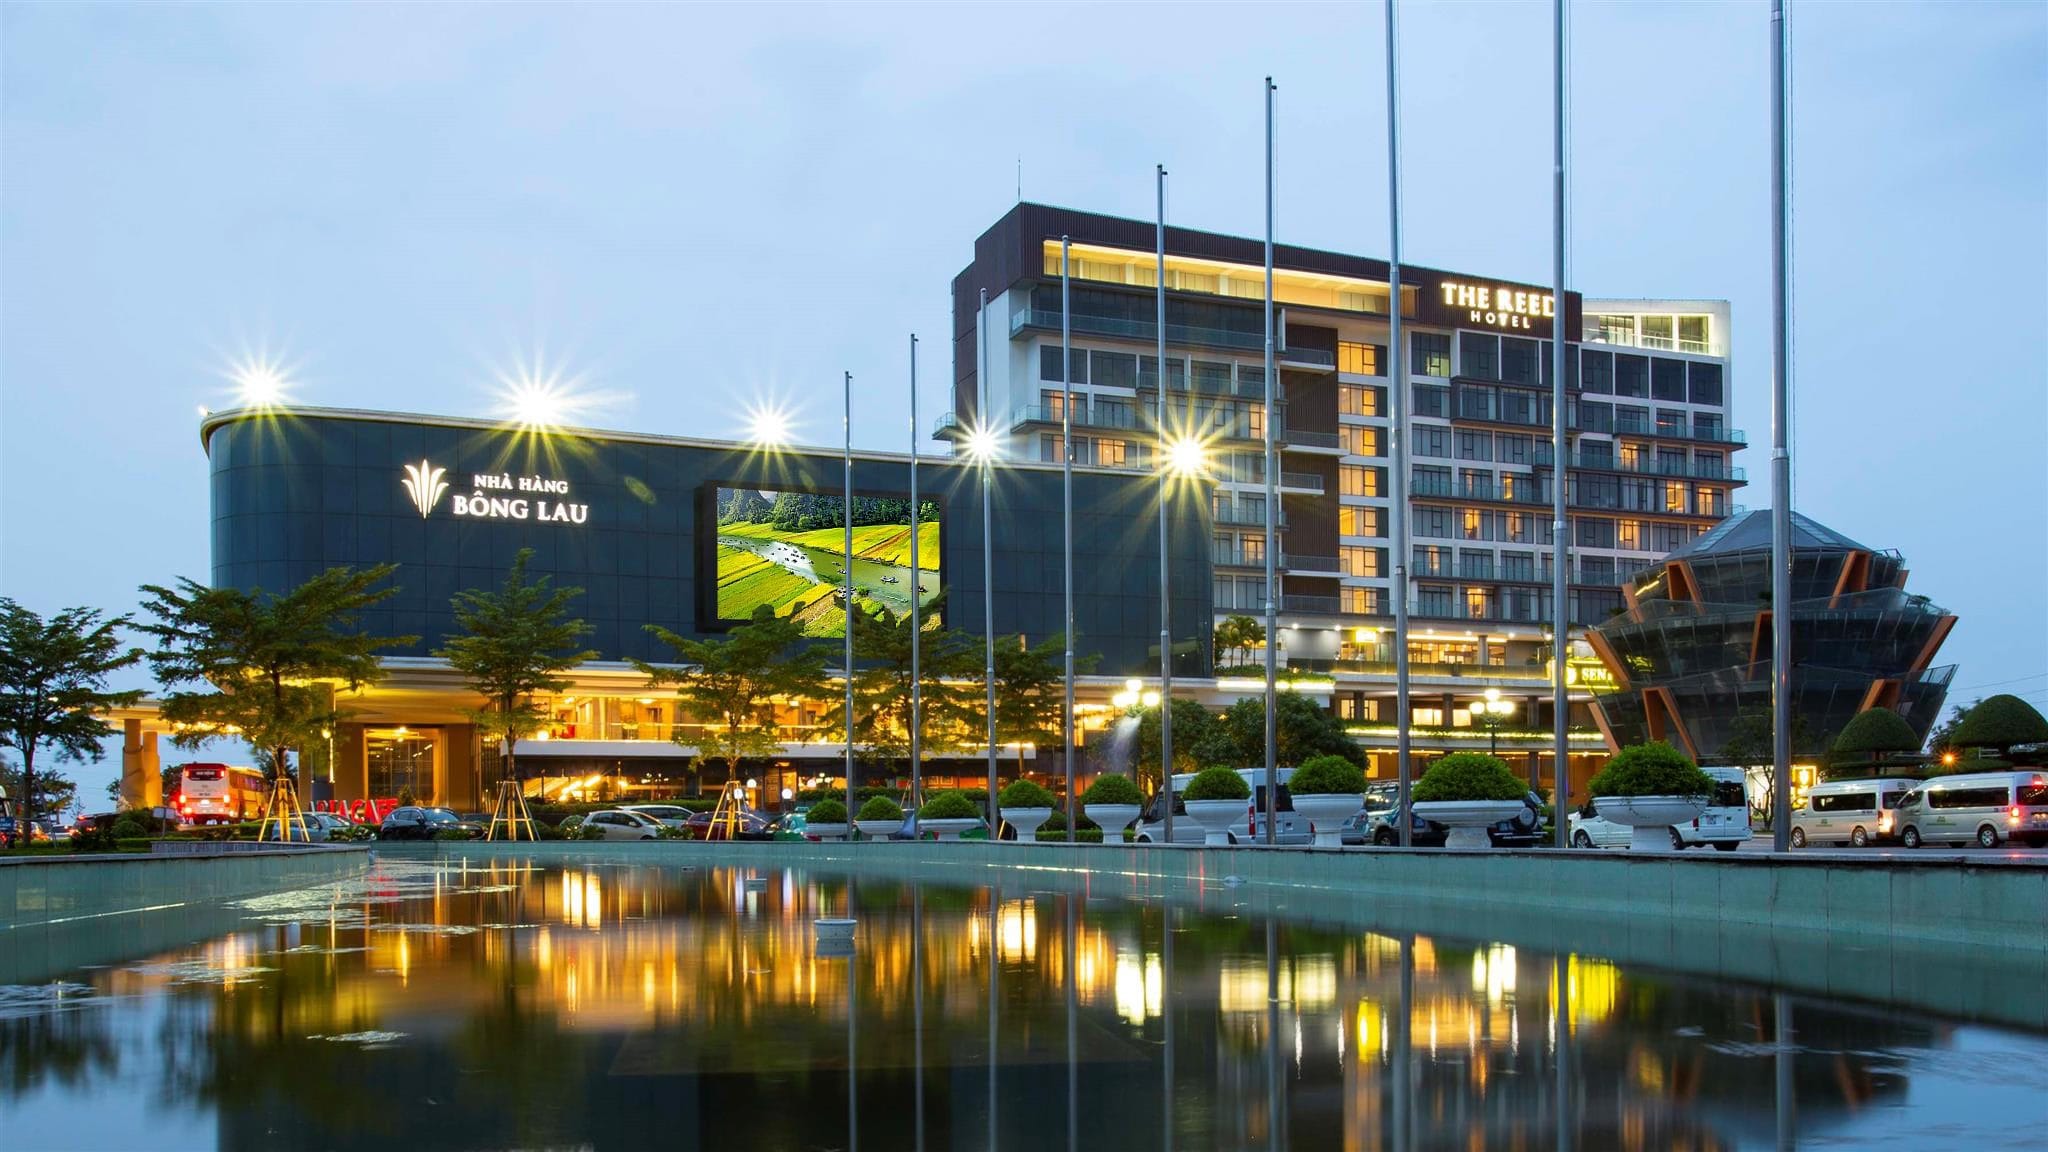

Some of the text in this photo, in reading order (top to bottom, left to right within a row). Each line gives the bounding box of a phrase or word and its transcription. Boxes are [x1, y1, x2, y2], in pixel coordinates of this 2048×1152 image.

[1440, 281, 1555, 318] THE REED
[1470, 310, 1531, 328] HOTEL
[473, 472, 569, 494] NHÀ HÀNG
[453, 490, 588, 523] BÔNG LAU
